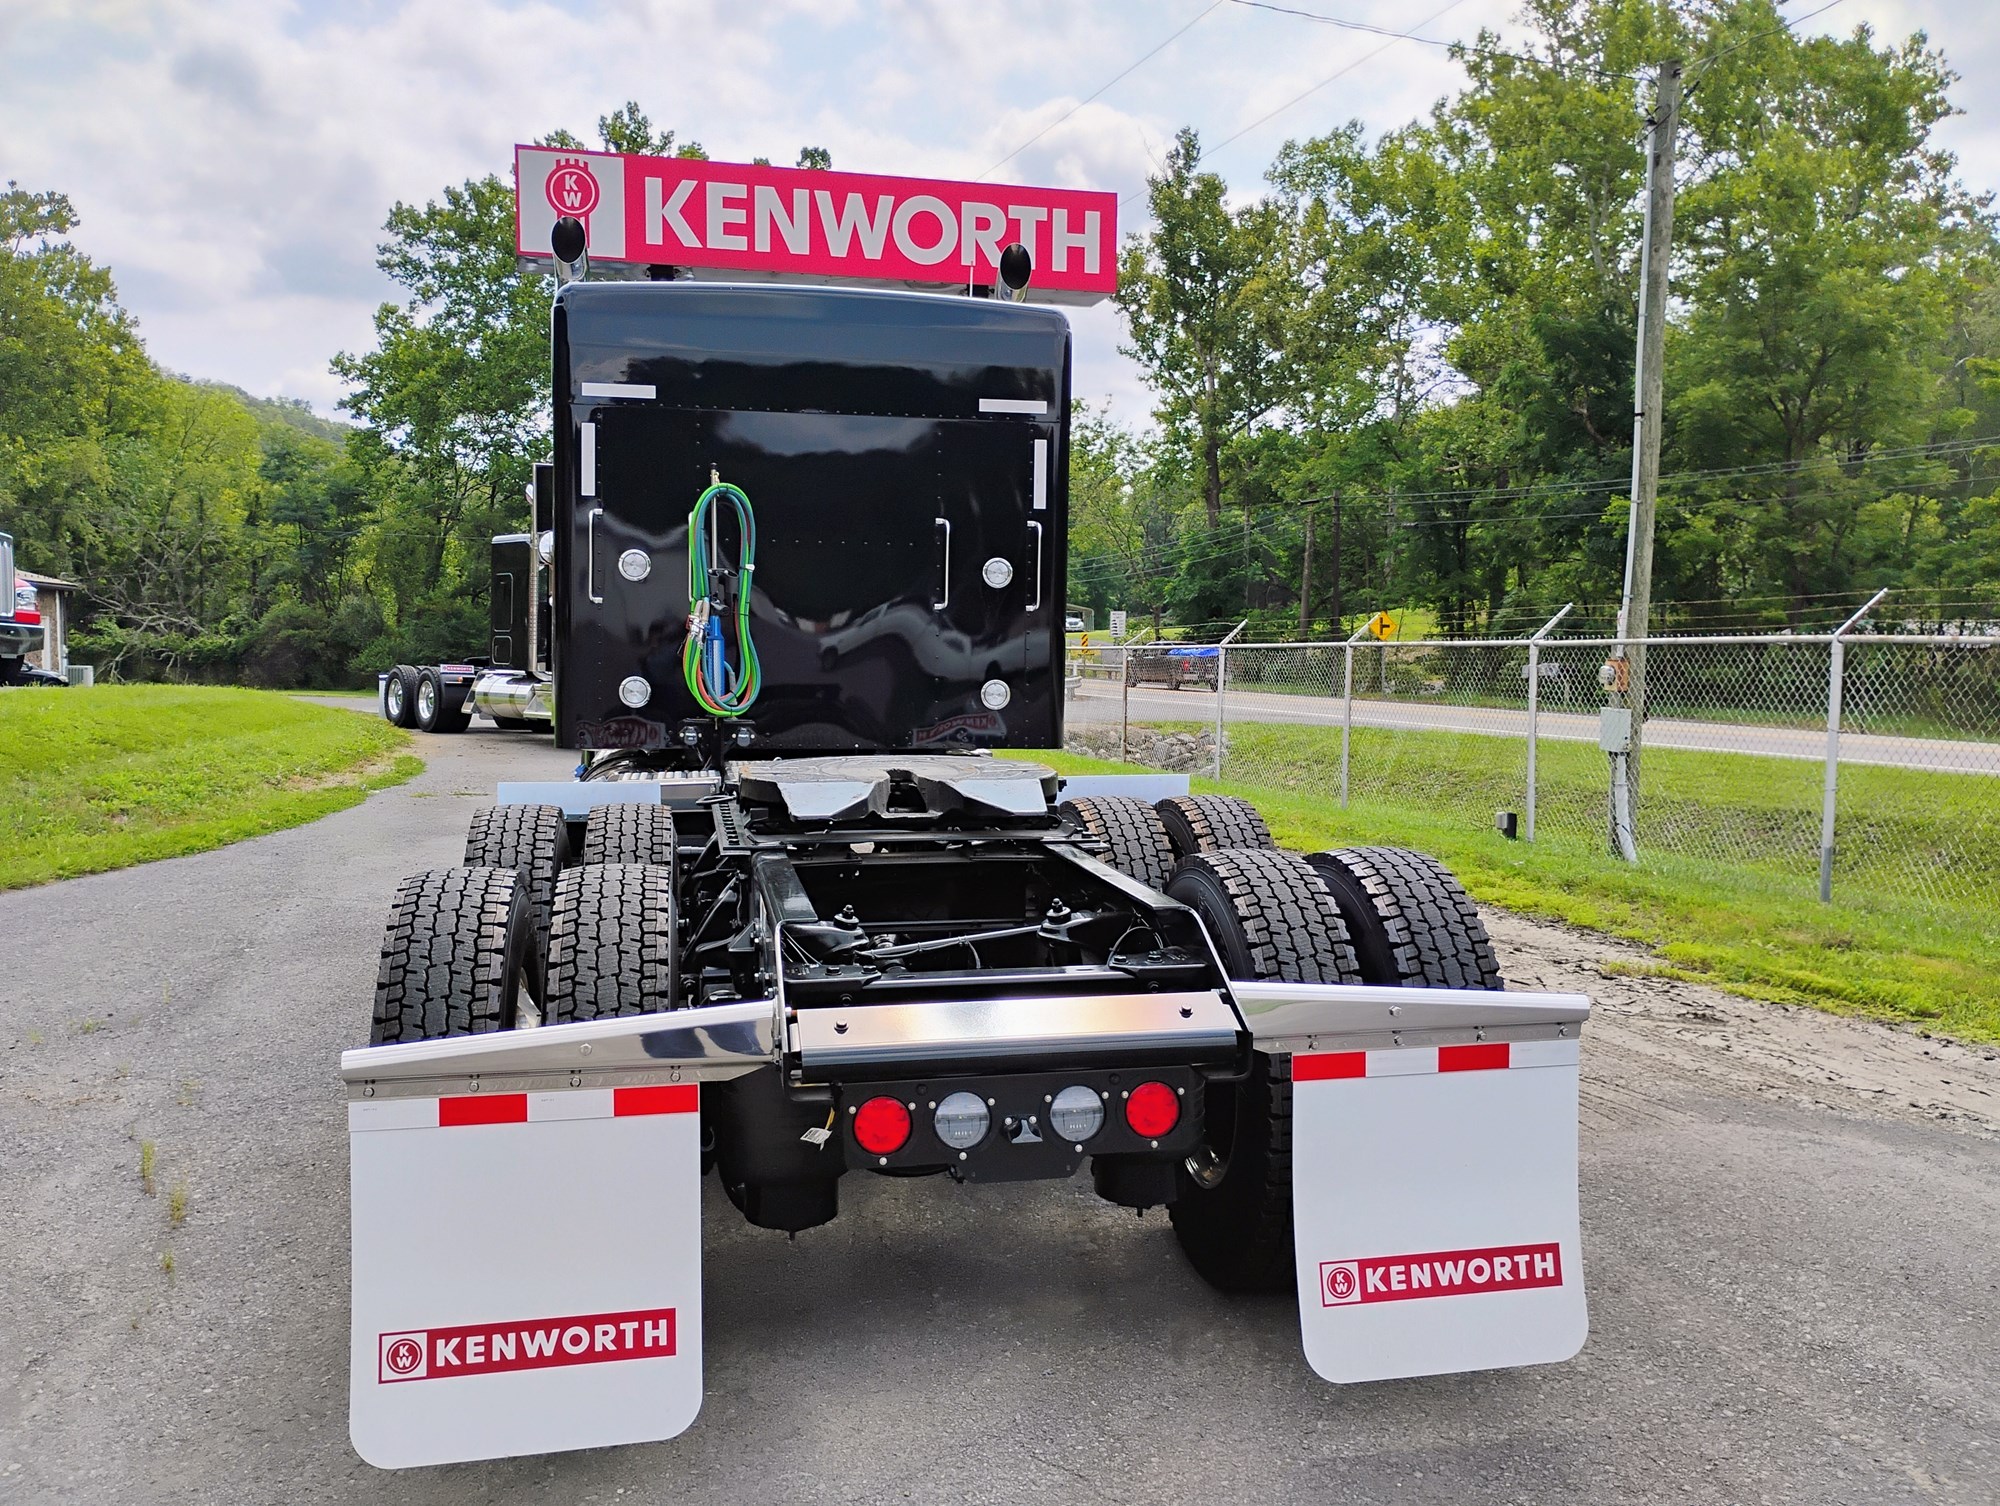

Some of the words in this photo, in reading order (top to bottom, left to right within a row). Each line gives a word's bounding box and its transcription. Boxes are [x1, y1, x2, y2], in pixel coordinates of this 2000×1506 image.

[644, 176, 1101, 275] KENWORTH
[1365, 1252, 1556, 1294] KENWORTH
[435, 1318, 669, 1368] KENWORTH
